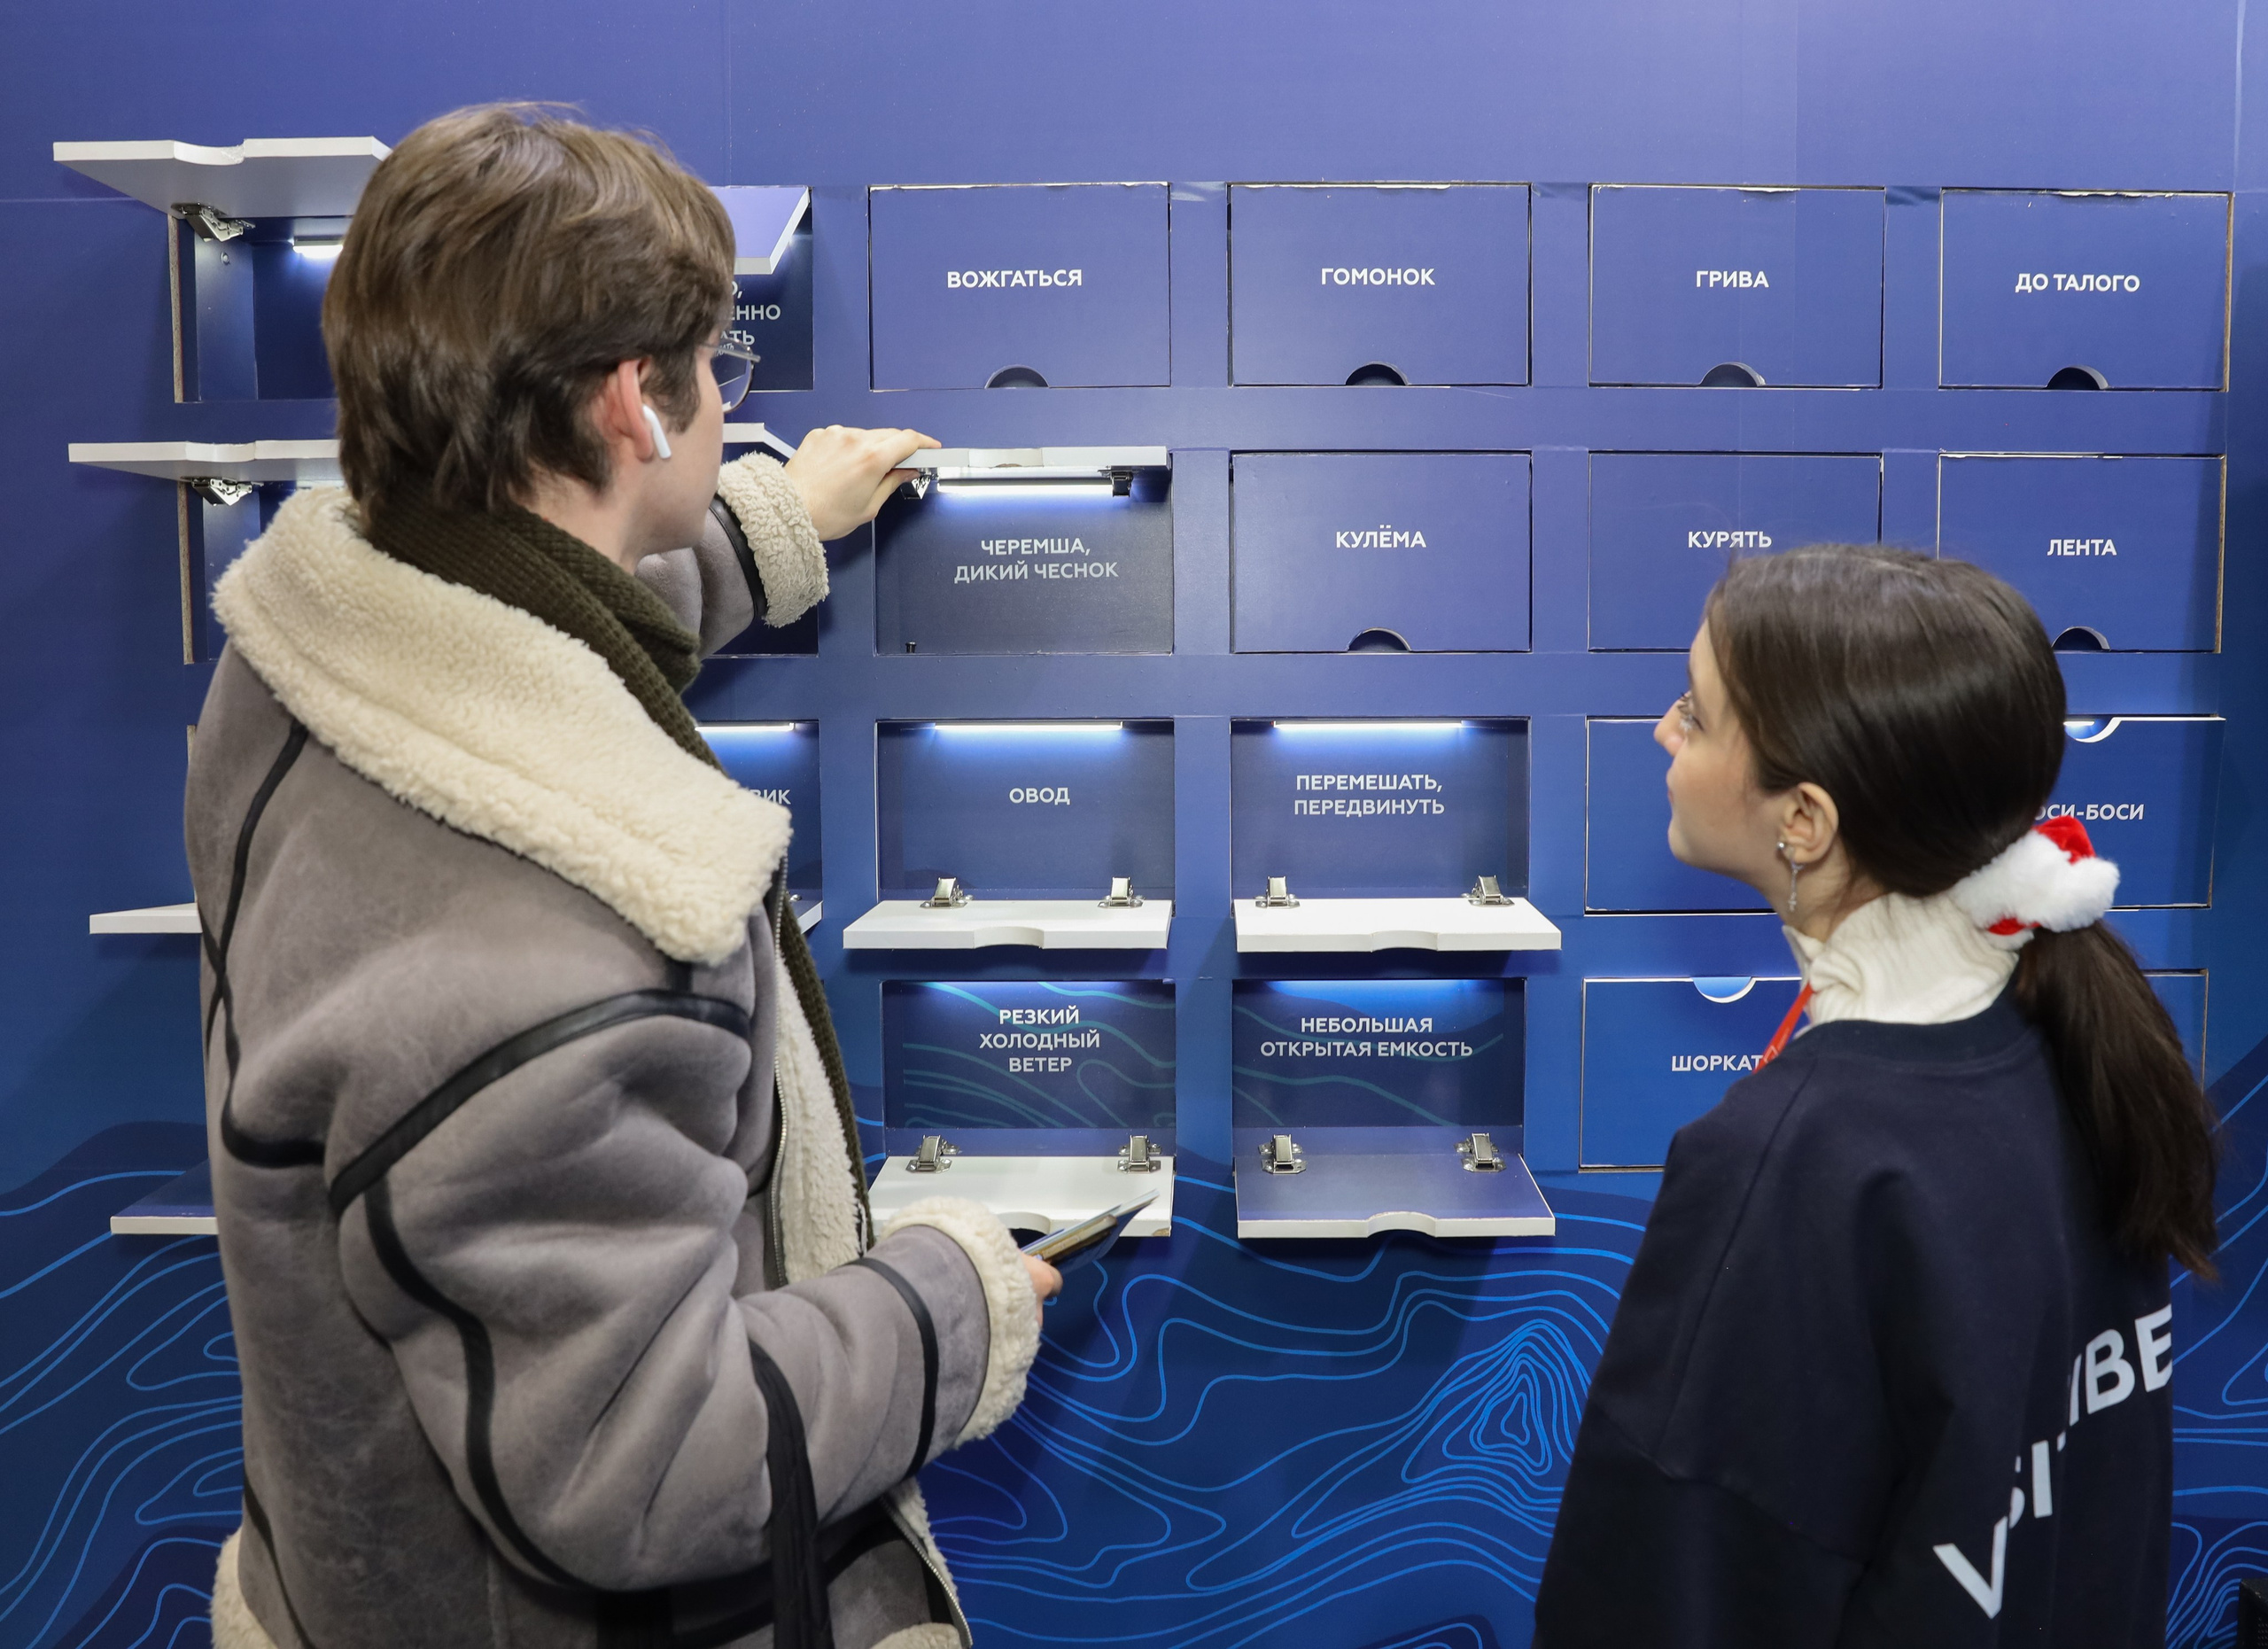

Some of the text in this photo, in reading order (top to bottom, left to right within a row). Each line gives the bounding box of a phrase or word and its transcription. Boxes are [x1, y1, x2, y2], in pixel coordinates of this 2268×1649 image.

[947, 268, 1083, 289] ВОЖГАТЬСЯ
[1321, 268, 1435, 286] ГОМОНОК
[1696, 270, 1769, 288] ГРИВА
[2015, 273, 2140, 293] ДО ТАЛОГО
[1336, 524, 1426, 548] КУЛЁМА
[1688, 531, 1773, 548] КУРЯТЬ
[981, 537, 1091, 557] ЧЕРЕМША,
[2047, 539, 2117, 556] ЛЕНТА
[954, 560, 1118, 584] ДИКИЙ ЧЕСНОК
[1296, 774, 1442, 796] ПЕРЕМЕШАТЬ,
[1009, 787, 1071, 806] ОВОД
[1294, 798, 1445, 818] ПЕРЕДВИНУТЬ
[999, 1004, 1080, 1025] РЕЗКИЙ
[1301, 1017, 1433, 1033] НЕБОЛЬШАЯ
[979, 1029, 1100, 1051] ХОЛОДНЫЙ
[1260, 1040, 1473, 1058] ОТКРЫТАЯ ЕМКОСТЬ
[1008, 1056, 1073, 1072] ВЕТЕР
[1671, 1054, 1763, 1072] ШОРКАТ
